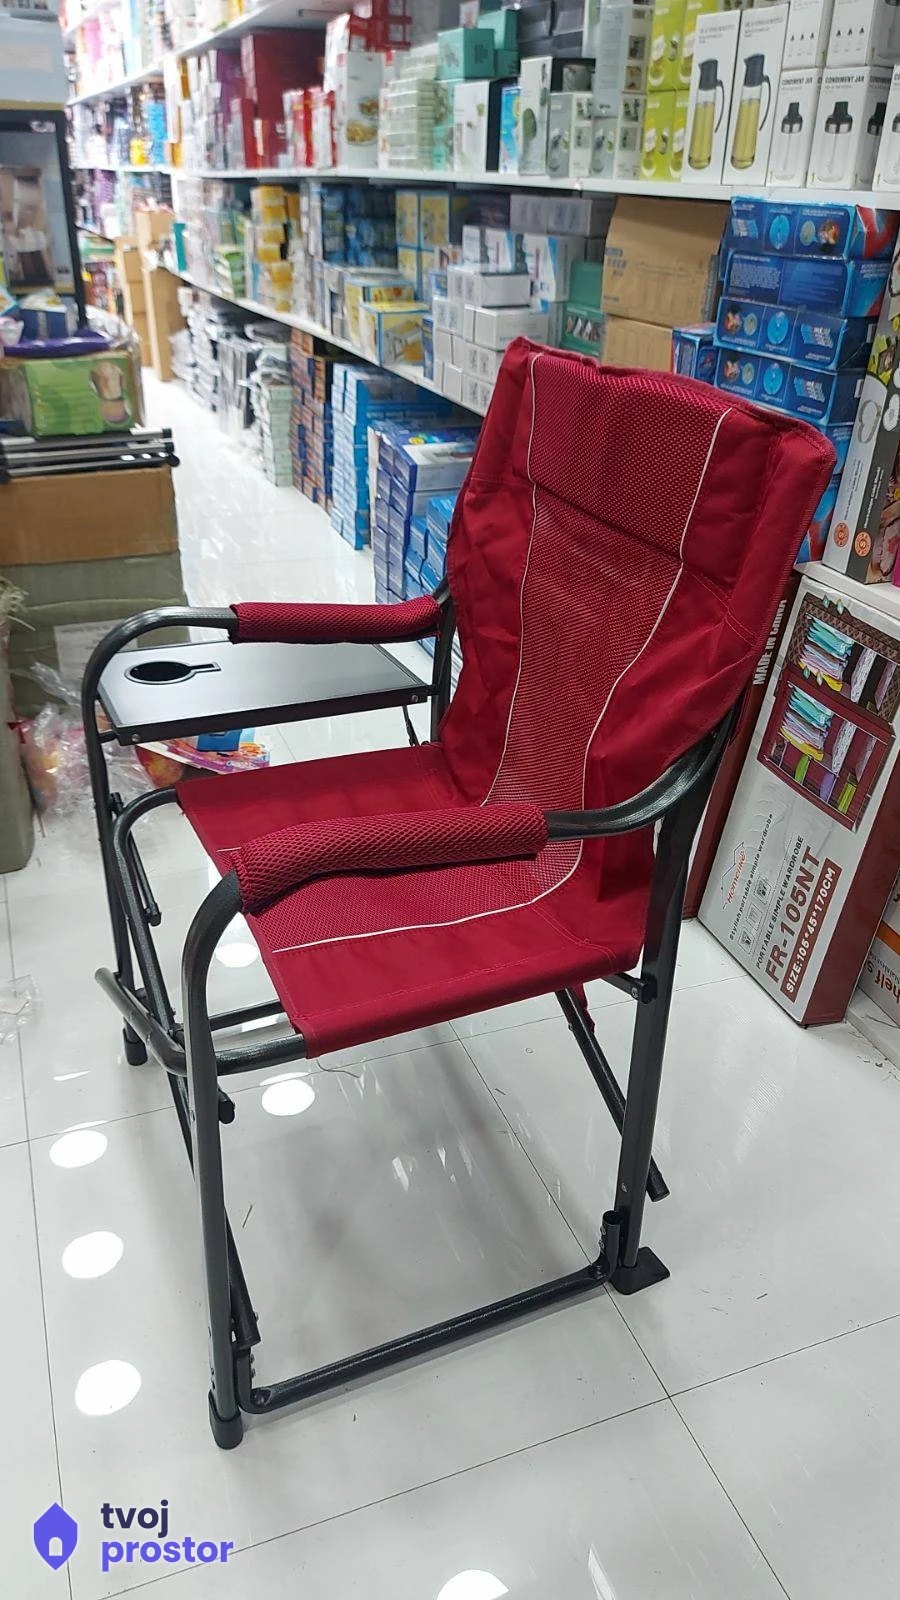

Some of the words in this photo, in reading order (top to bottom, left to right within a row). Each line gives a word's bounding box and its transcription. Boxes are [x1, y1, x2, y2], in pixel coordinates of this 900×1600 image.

[824, 76, 854, 84] CONDIMENT
[855, 75, 865, 83] JAR
[753, 652, 772, 685] MADE
[765, 637, 777, 650] IN
[729, 911, 742, 941] Stylish
[740, 880, 752, 912] portable
[750, 853, 760, 879] simple
[758, 814, 773, 852] wardrobe
[756, 922, 775, 970] PORTABLE
[772, 891, 786, 922] SIMPLE
[782, 835, 805, 889] WARDROBE
[765, 846, 820, 984] FR-105NT
[875, 969, 900, 1004] helf
